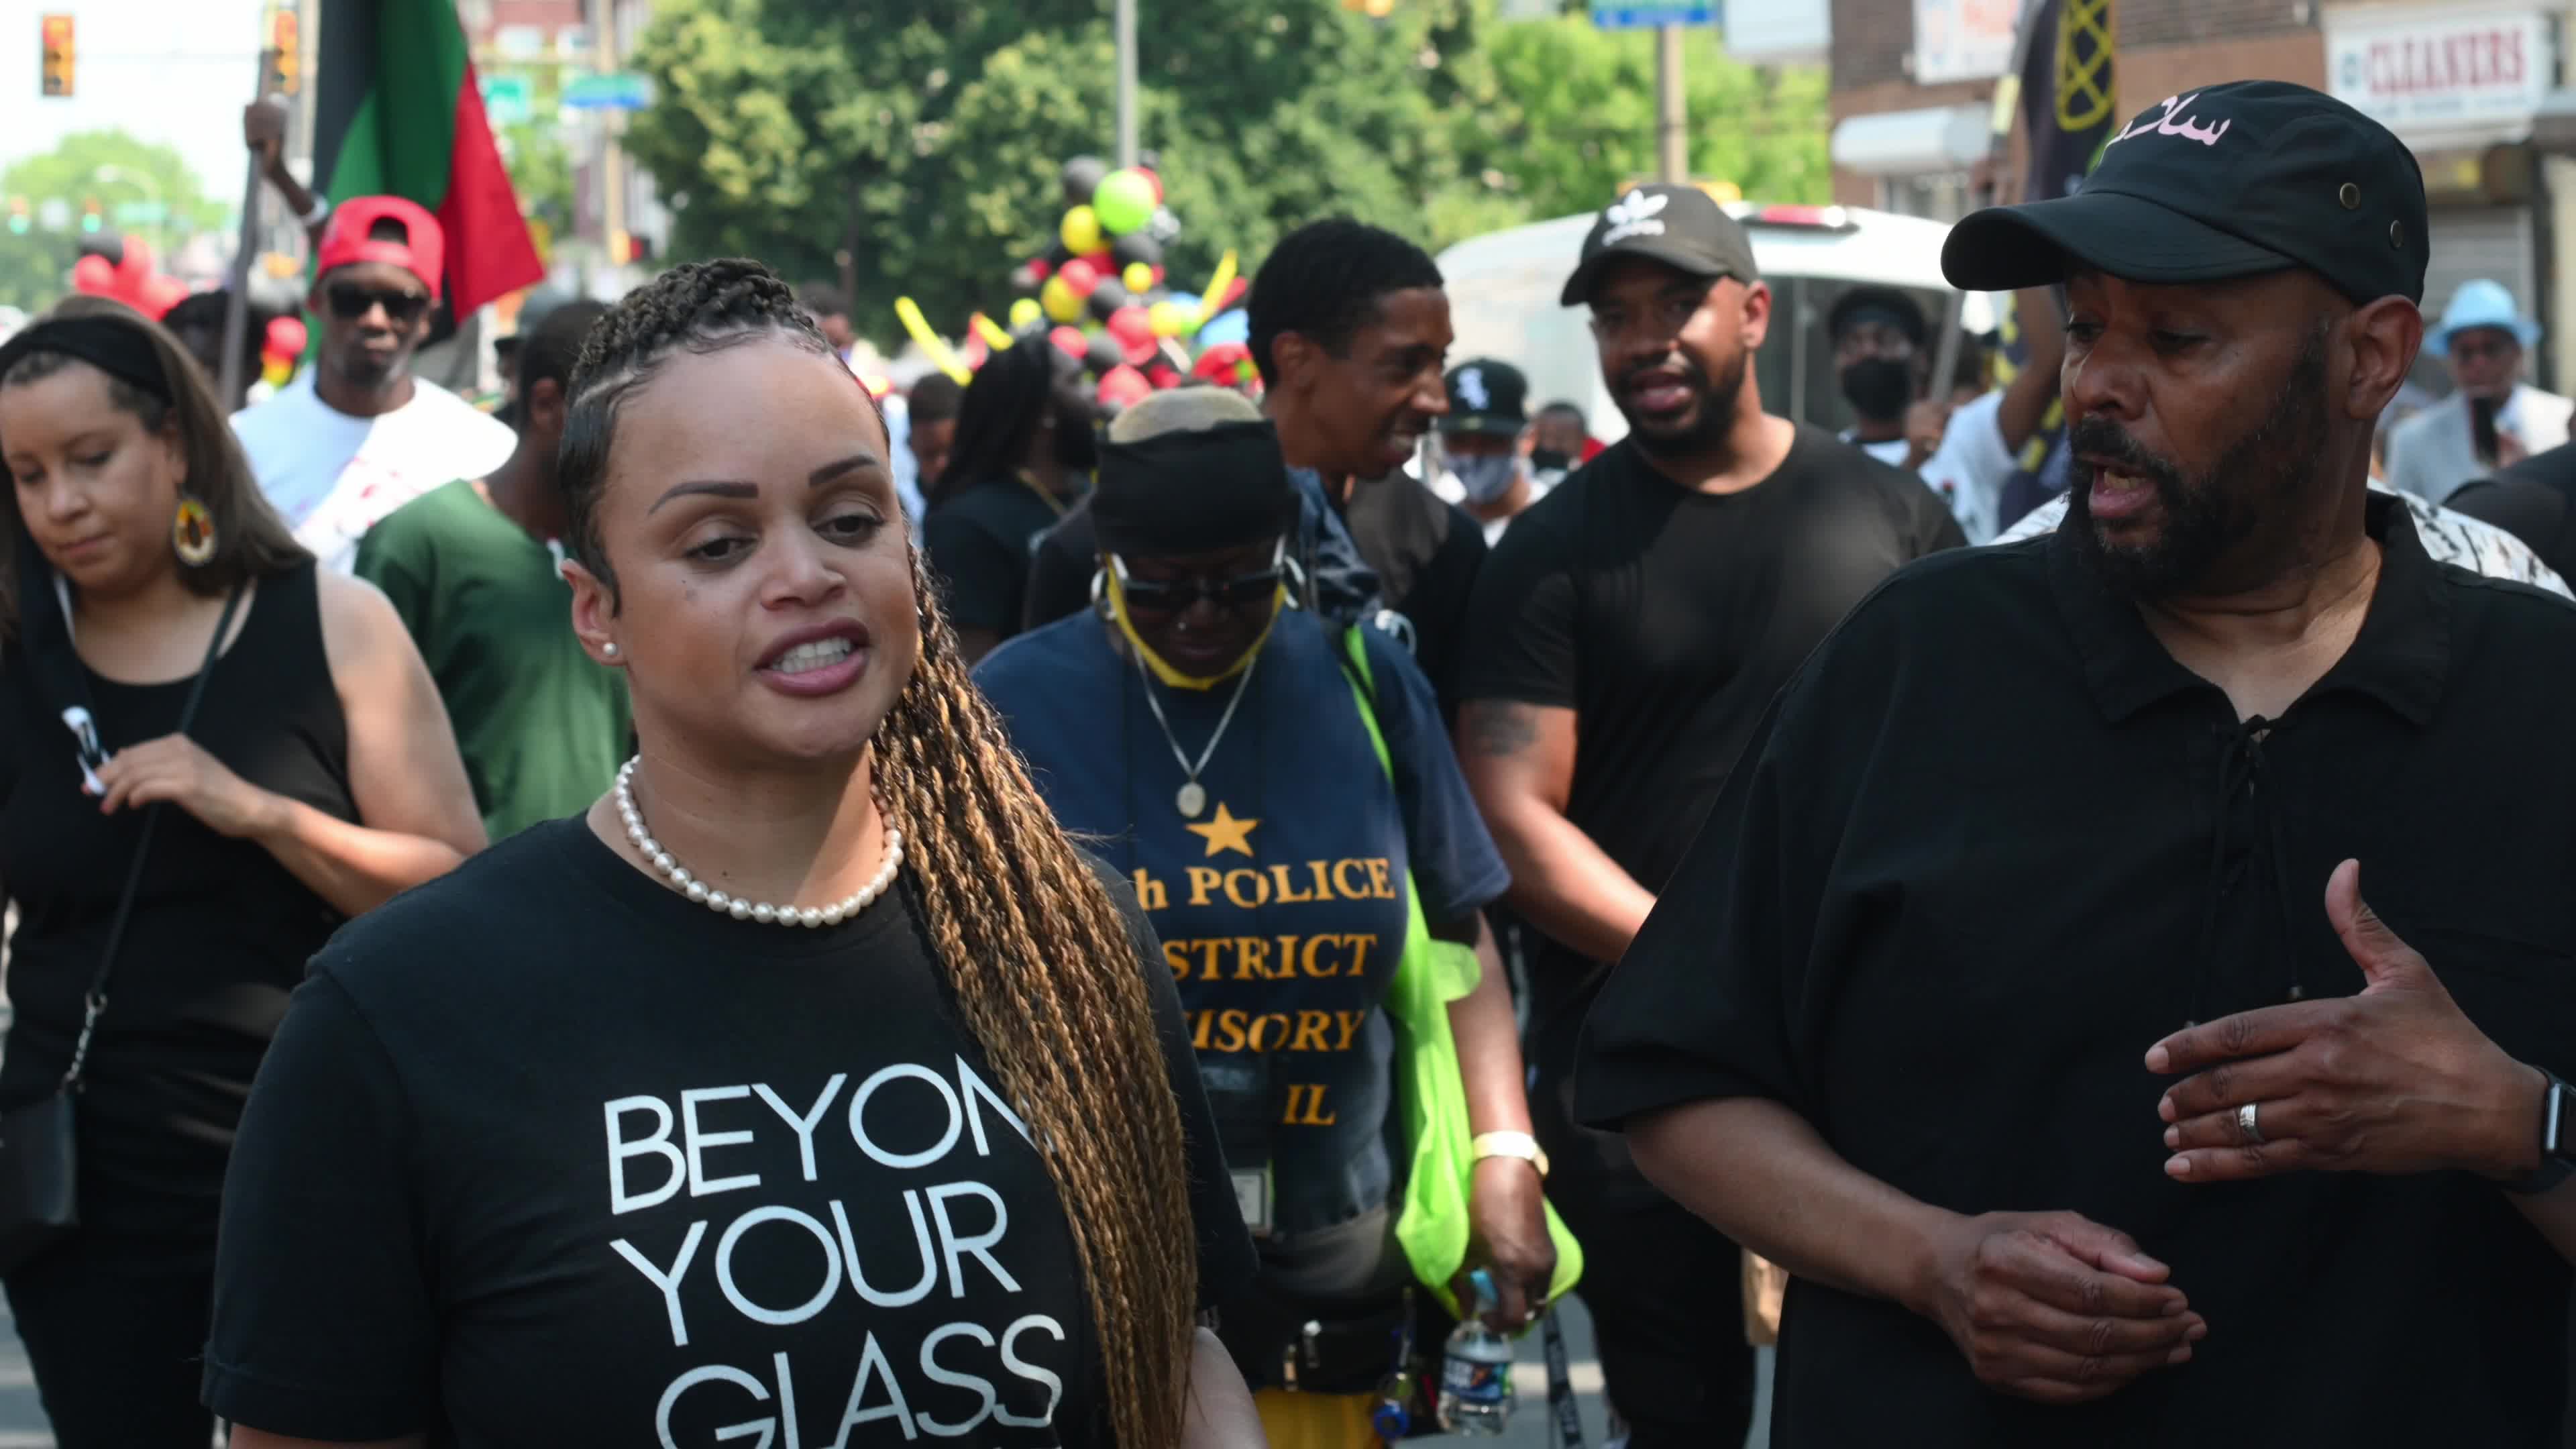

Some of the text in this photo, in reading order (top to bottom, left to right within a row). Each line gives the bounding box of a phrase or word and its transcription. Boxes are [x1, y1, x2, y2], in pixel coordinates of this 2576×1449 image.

[2366, 30, 2526, 97] CLEANERS
[1185, 857, 1396, 908] POLICE
[1163, 934, 1377, 979] STRICT
[1190, 1010, 1364, 1053] ISORY
[604, 1053, 1057, 1216] BEYON
[609, 1180, 1022, 1347] YOUR
[655, 1314, 1065, 1449] GLASS
